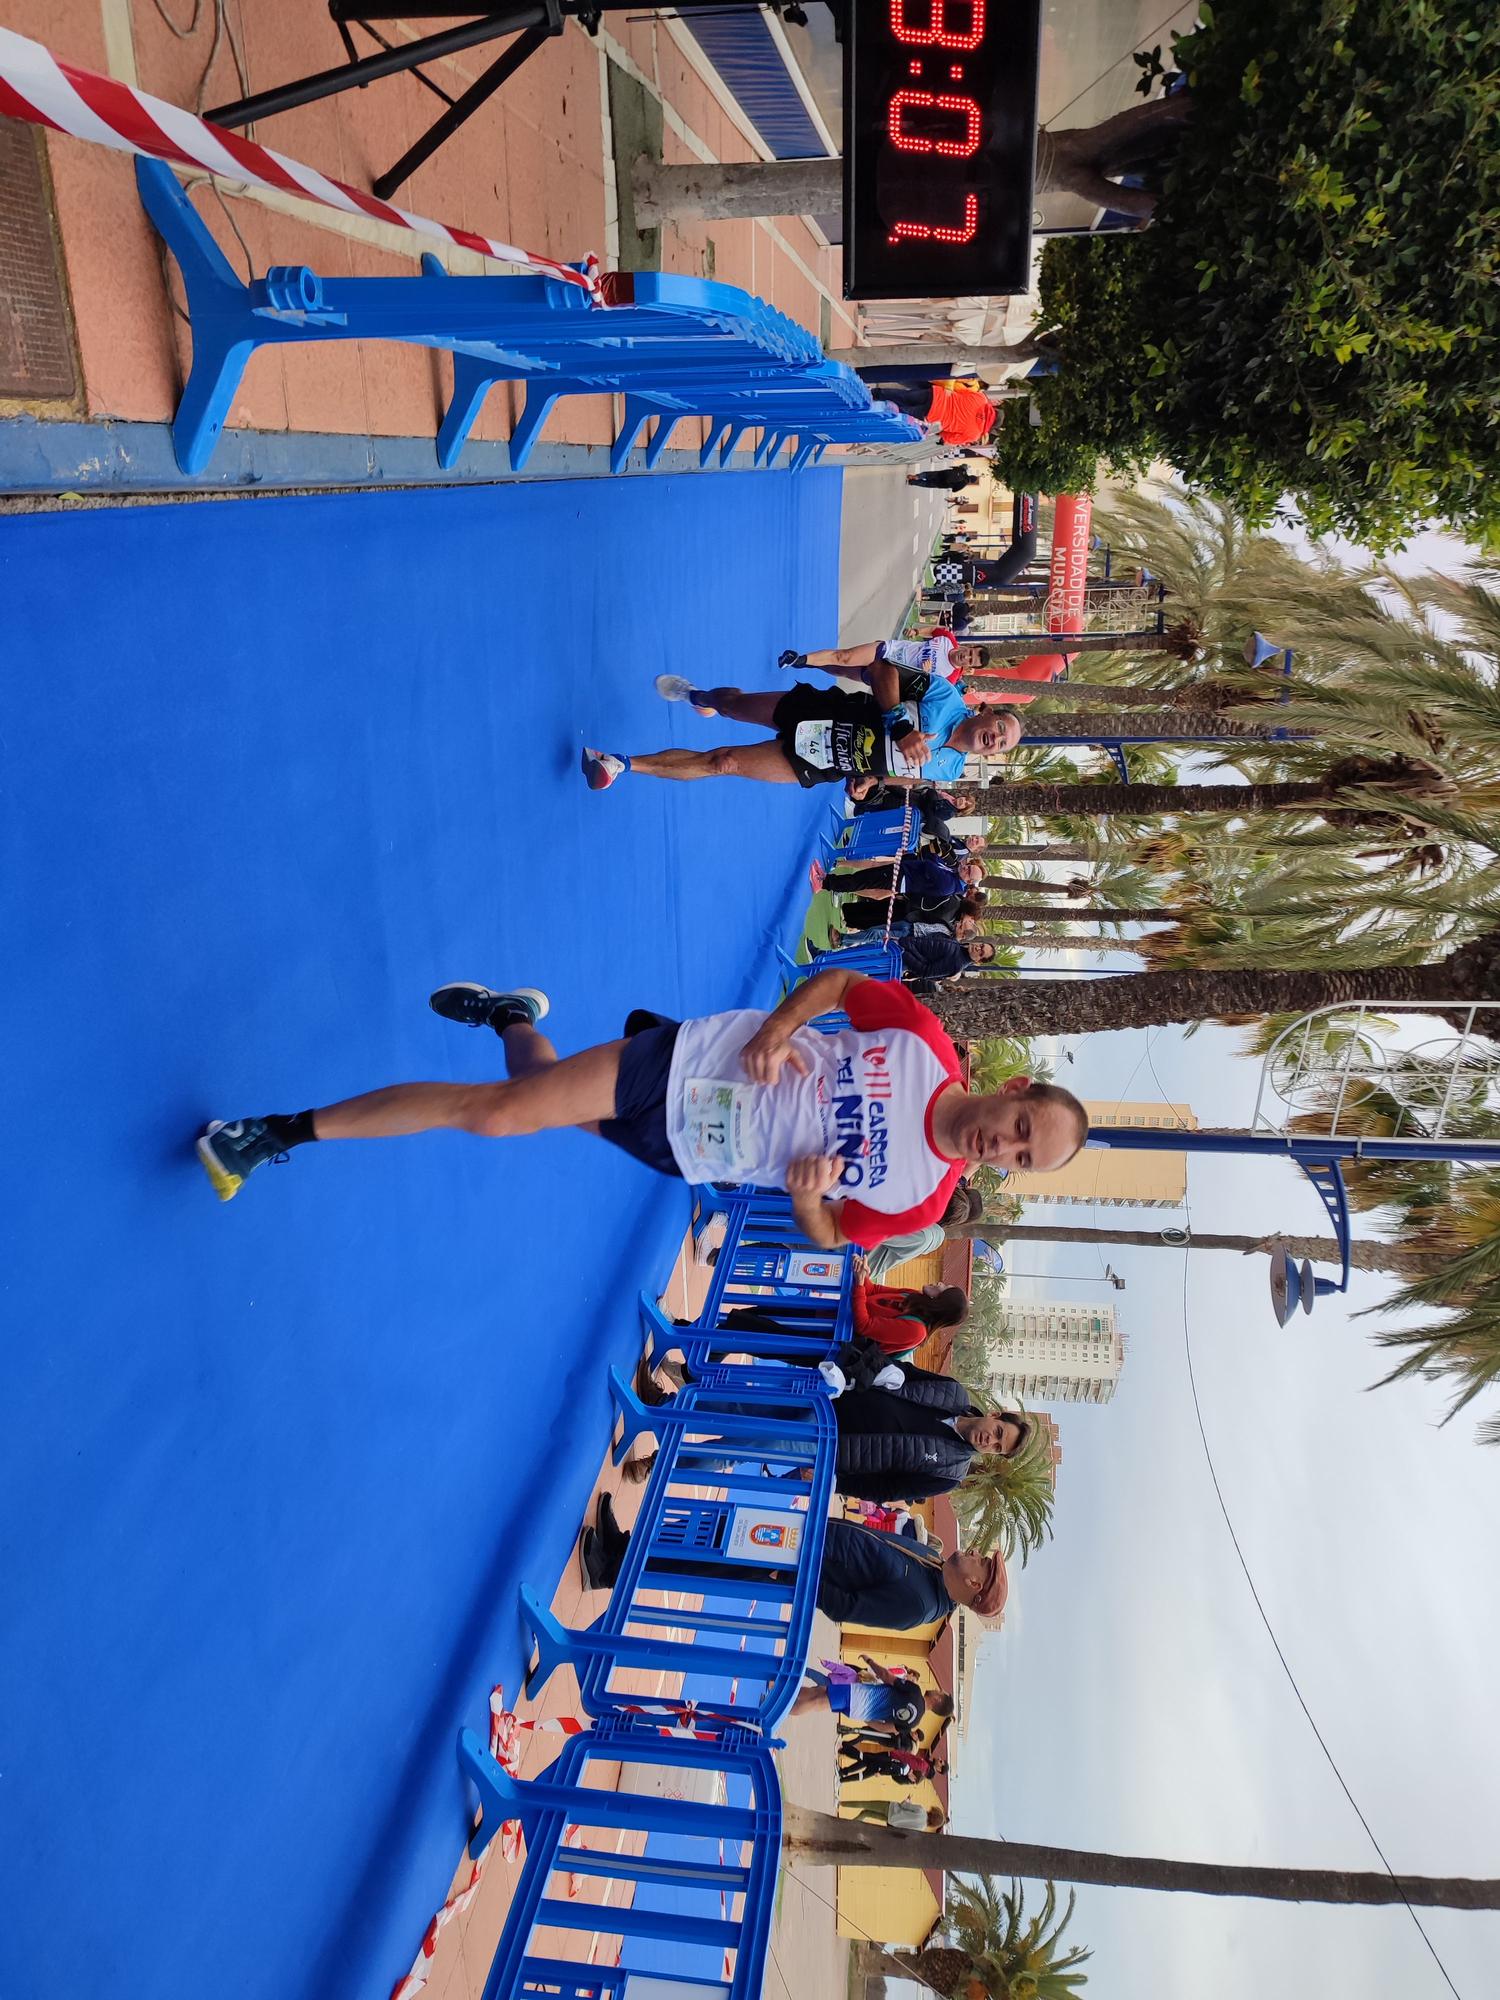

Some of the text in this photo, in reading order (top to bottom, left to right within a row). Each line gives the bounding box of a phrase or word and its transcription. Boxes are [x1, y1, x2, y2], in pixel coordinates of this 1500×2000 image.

[1048, 546, 1067, 618] MURCIA
[1068, 497, 1089, 618] IVERSIDAD DE
[809, 740, 820, 755] 46
[837, 1056, 854, 1089] DEL
[707, 1120, 725, 1145] 12
[862, 1046, 892, 1188] VIII CARRERA
